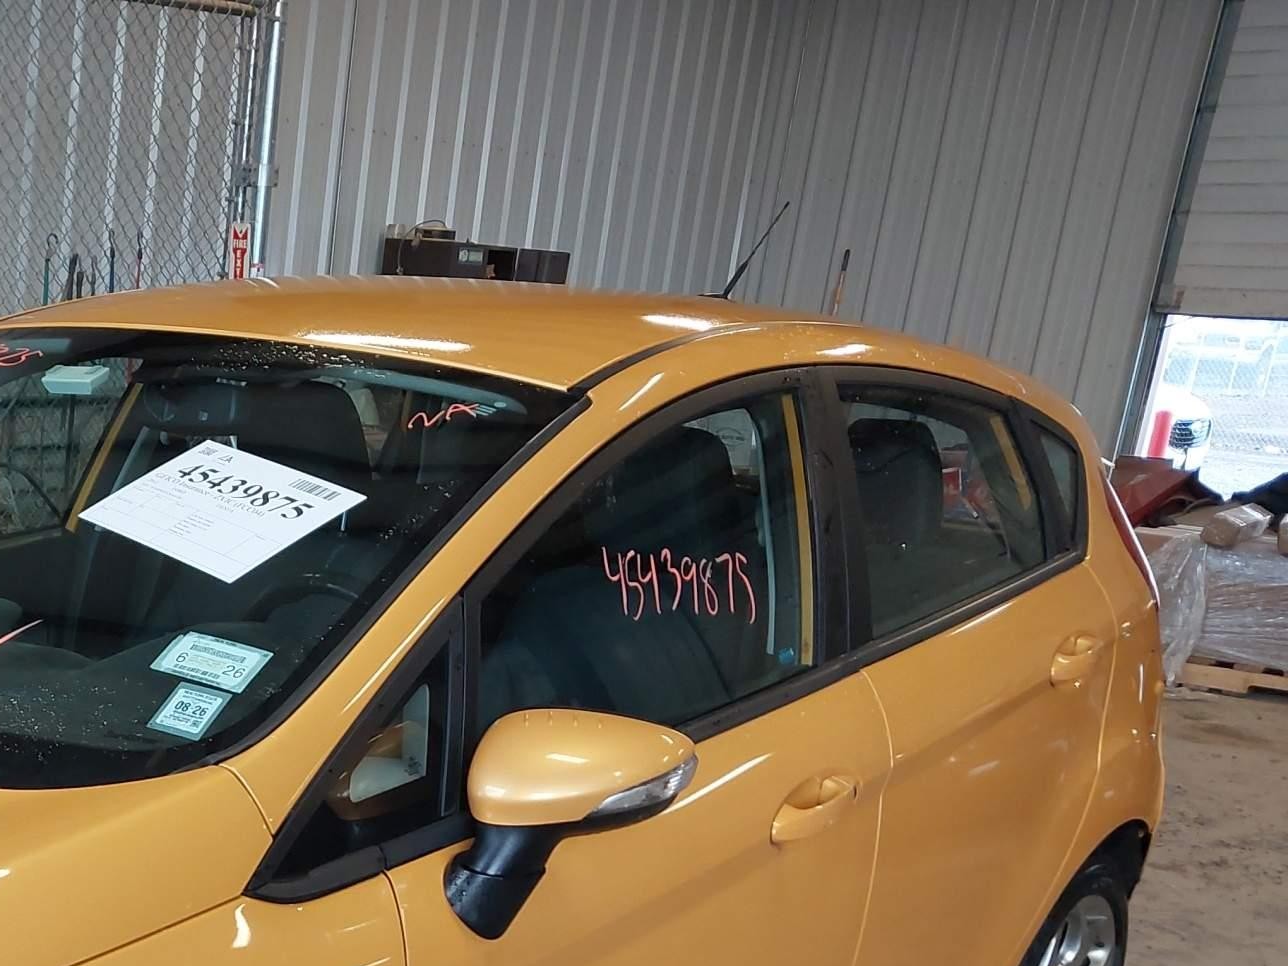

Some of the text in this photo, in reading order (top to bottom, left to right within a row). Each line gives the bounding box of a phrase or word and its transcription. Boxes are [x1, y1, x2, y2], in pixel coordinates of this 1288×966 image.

[233, 239, 248, 249] FIRE
[178, 464, 315, 519] 45439875
[601, 546, 756, 624] 45439875
[175, 652, 189, 663] 6
[222, 664, 246, 679] 26
